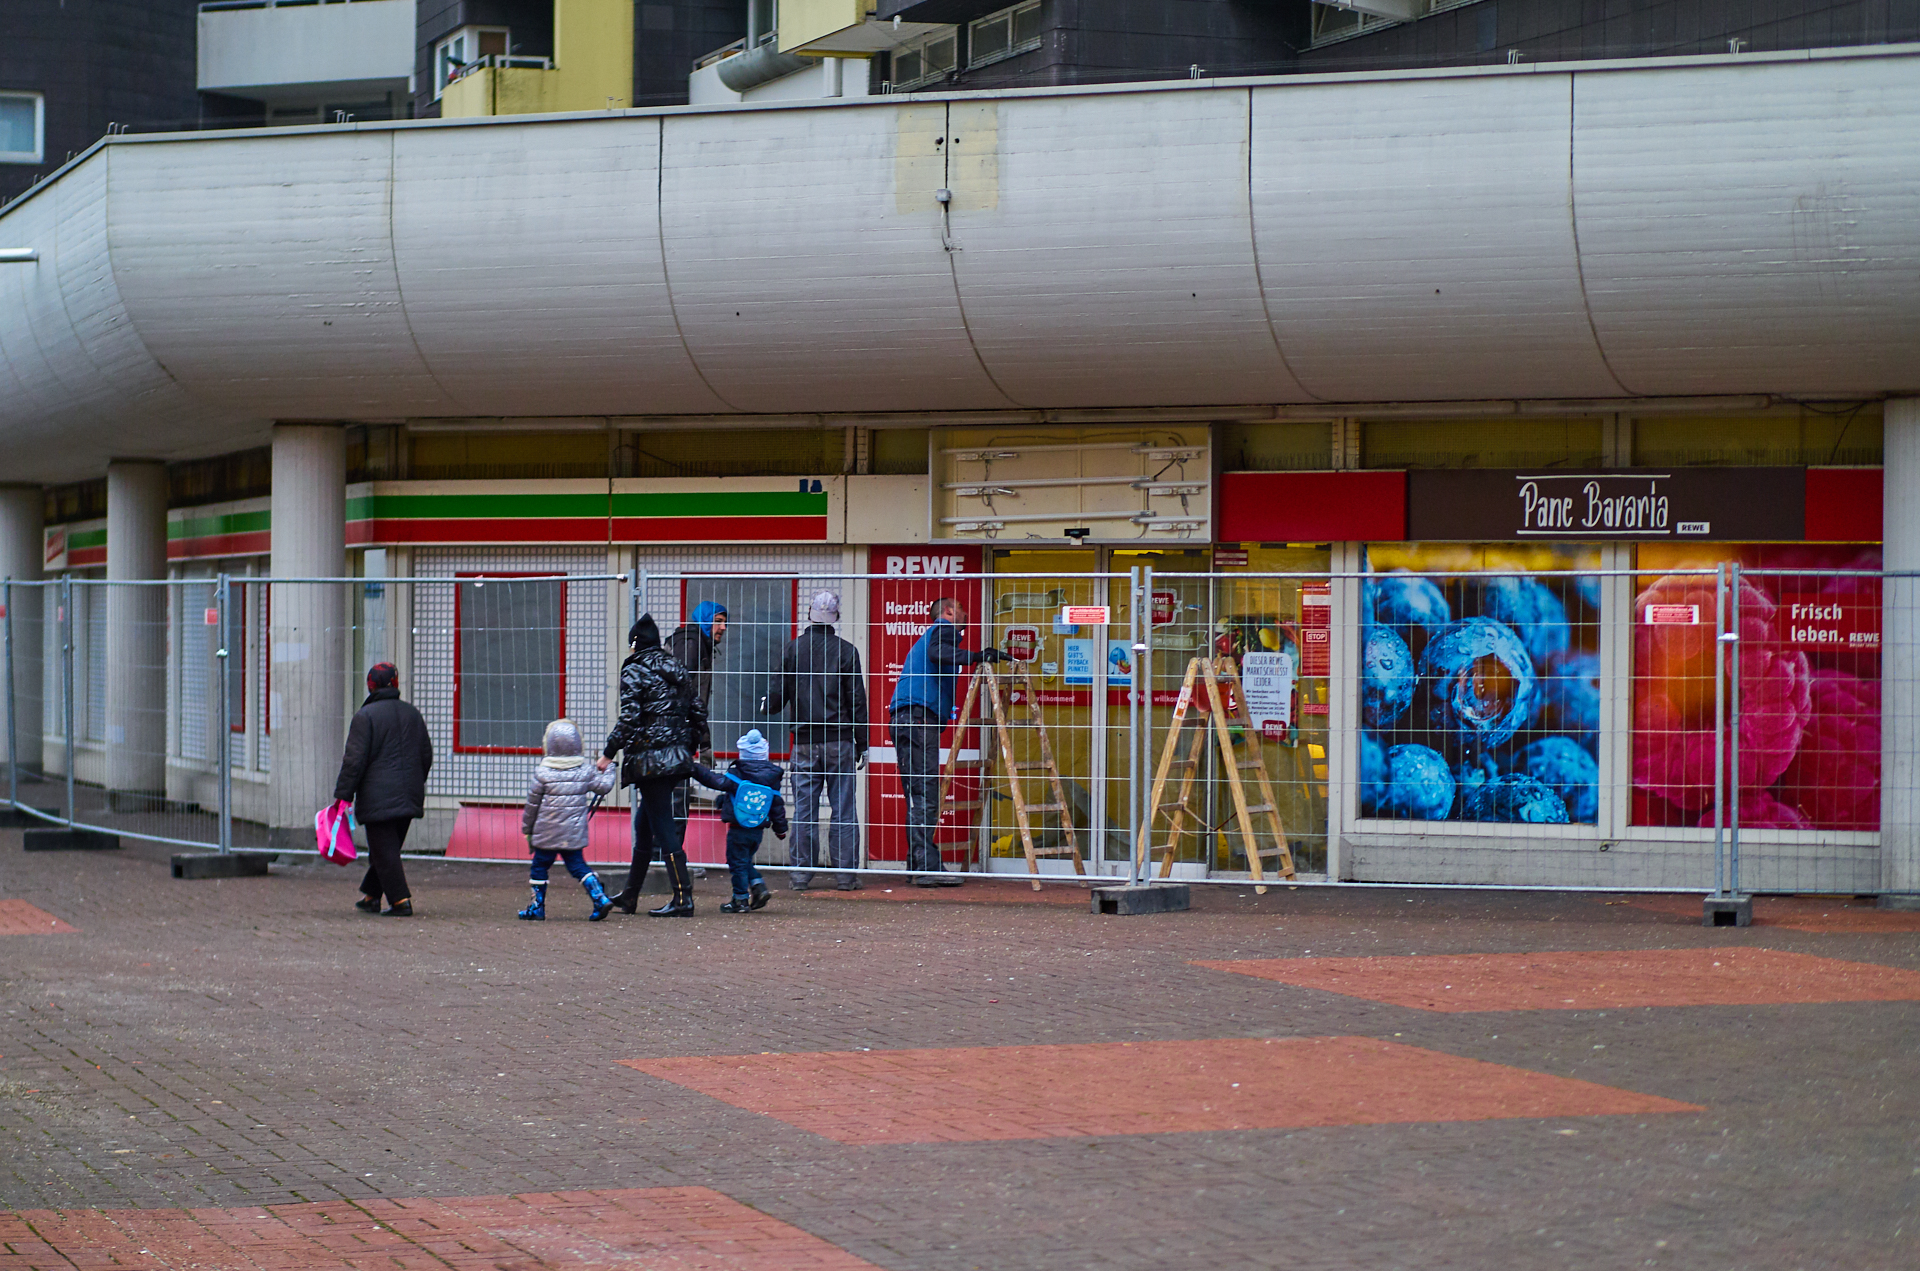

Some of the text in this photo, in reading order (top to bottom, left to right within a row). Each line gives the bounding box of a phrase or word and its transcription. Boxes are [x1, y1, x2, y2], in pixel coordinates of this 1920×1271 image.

[1519, 480, 1669, 528] Pane Bavaria
[886, 556, 965, 580] REWE
[885, 601, 933, 615] Herzlic
[1791, 603, 1842, 620] Frisch
[1791, 625, 1880, 642] leben. REWE
[1249, 655, 1284, 665] DIESER REWE
[1246, 667, 1288, 676] MARKT SCHLIESST
[1253, 677, 1273, 686] LEIDER.
[1265, 723, 1283, 731] REWE
